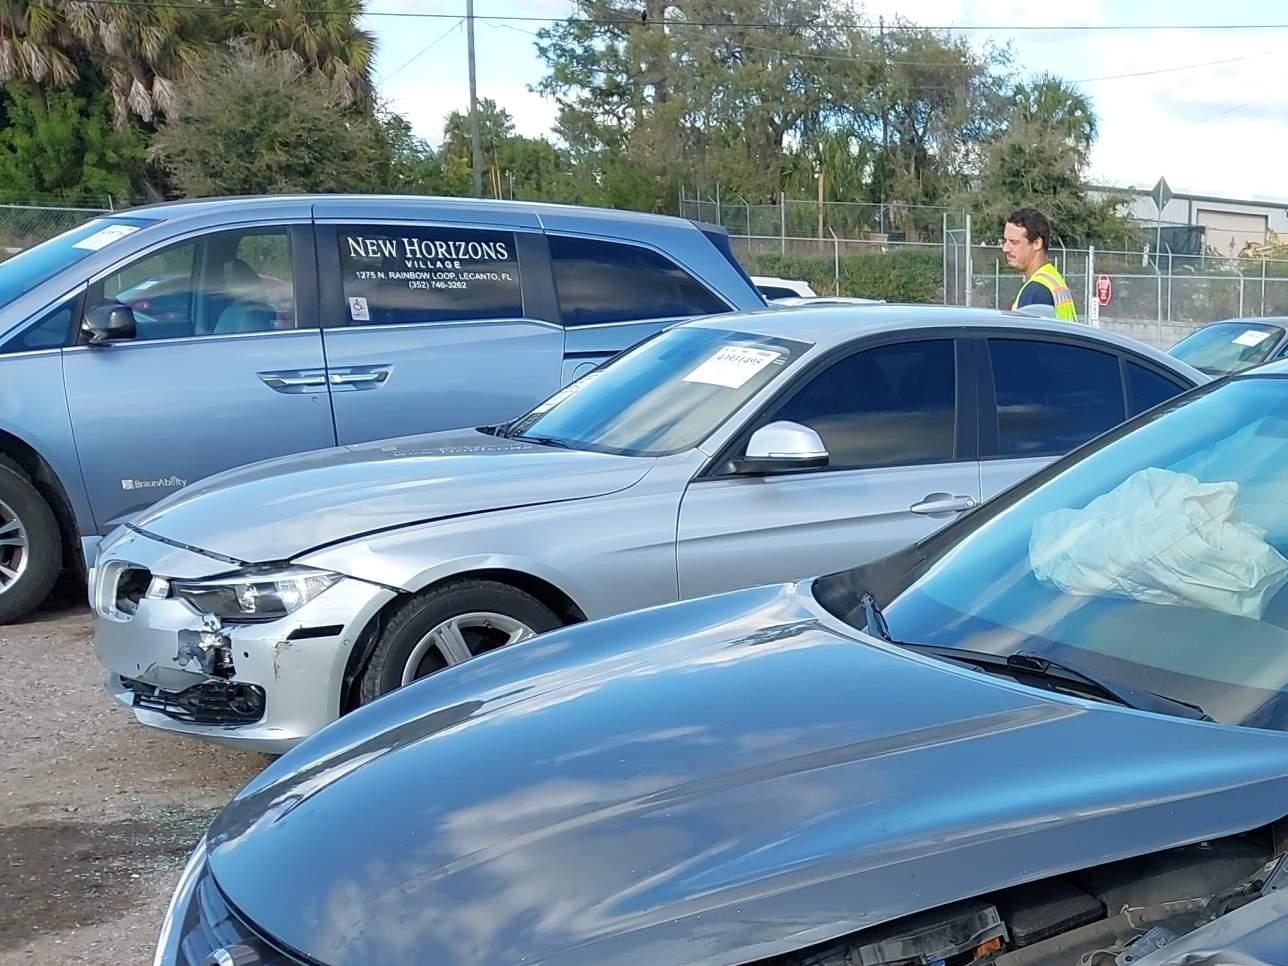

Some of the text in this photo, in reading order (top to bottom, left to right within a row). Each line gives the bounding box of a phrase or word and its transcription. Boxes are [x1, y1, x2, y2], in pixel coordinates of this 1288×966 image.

[347, 236, 508, 260] NEW HORIZONS
[405, 260, 461, 269] VILLAGE
[355, 271, 513, 282] 1275 N. RAINBOW LOOP, LECANTO, FL
[408, 281, 430, 290] (352)
